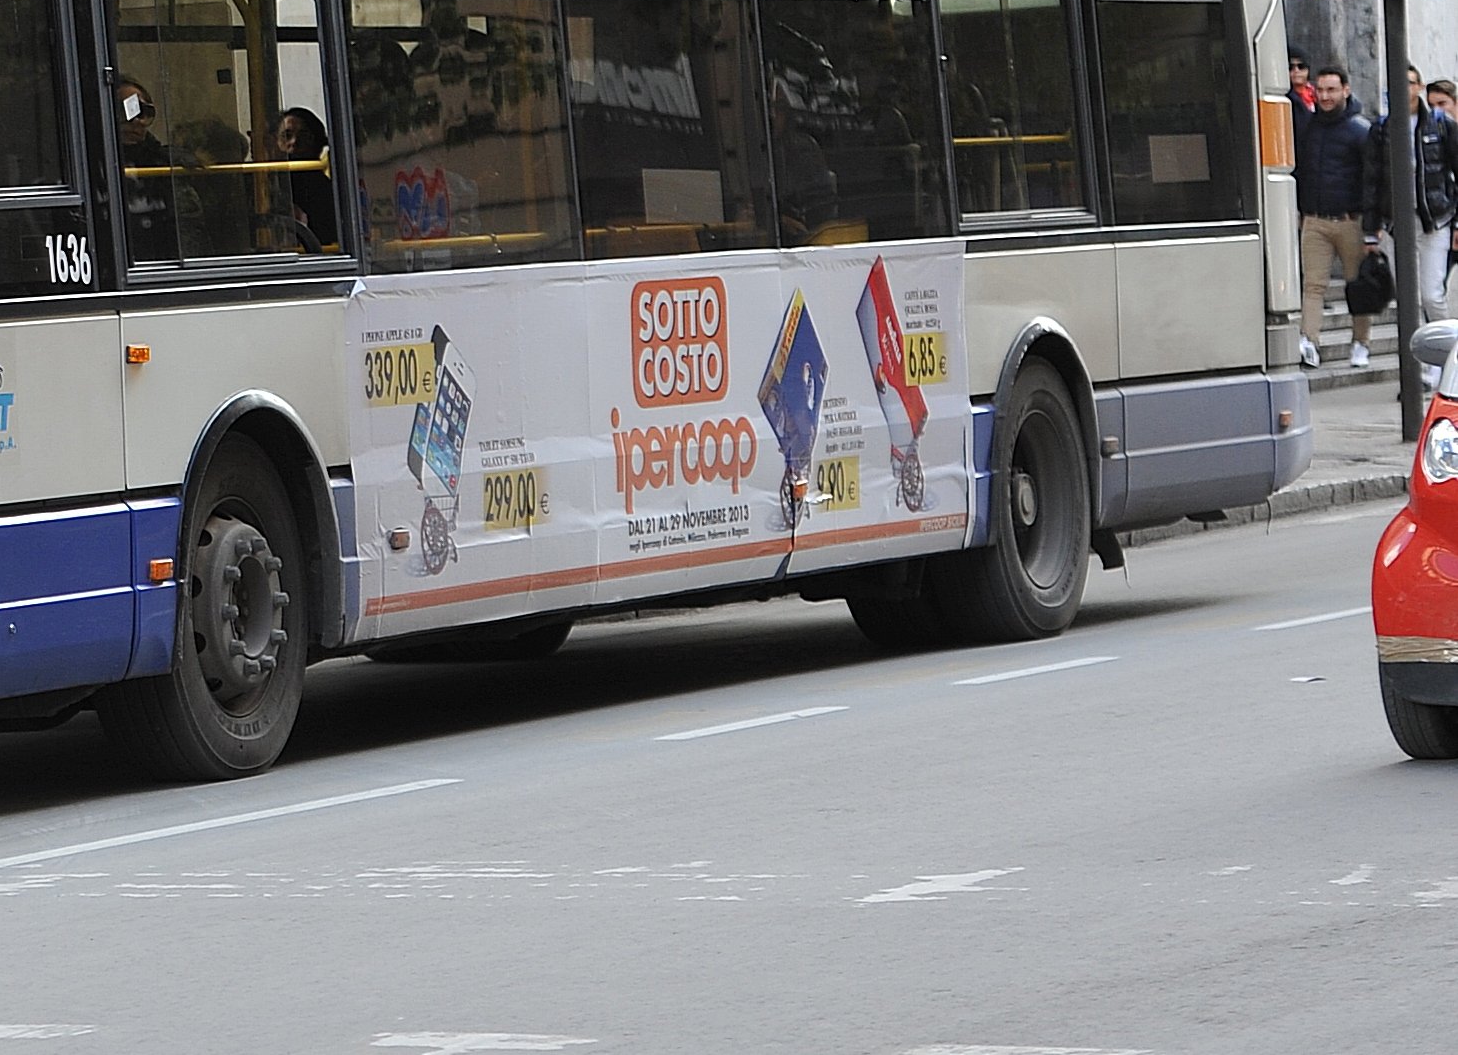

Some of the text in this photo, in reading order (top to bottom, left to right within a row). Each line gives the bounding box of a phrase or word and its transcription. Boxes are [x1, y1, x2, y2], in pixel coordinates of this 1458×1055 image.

[45, 234, 93, 285] 1636
[638, 286, 721, 342] SOTTO
[364, 348, 432, 405] 339,00 €
[638, 341, 724, 398] COSTO
[909, 336, 935, 385] 6,85
[939, 355, 947, 376] €
[610, 406, 759, 515] ipercoop
[485, 471, 550, 528] 299,00 €
[848, 481, 856, 501] €
[628, 504, 749, 537] DAL 21 AL 29 NOVEMBRE 2013
